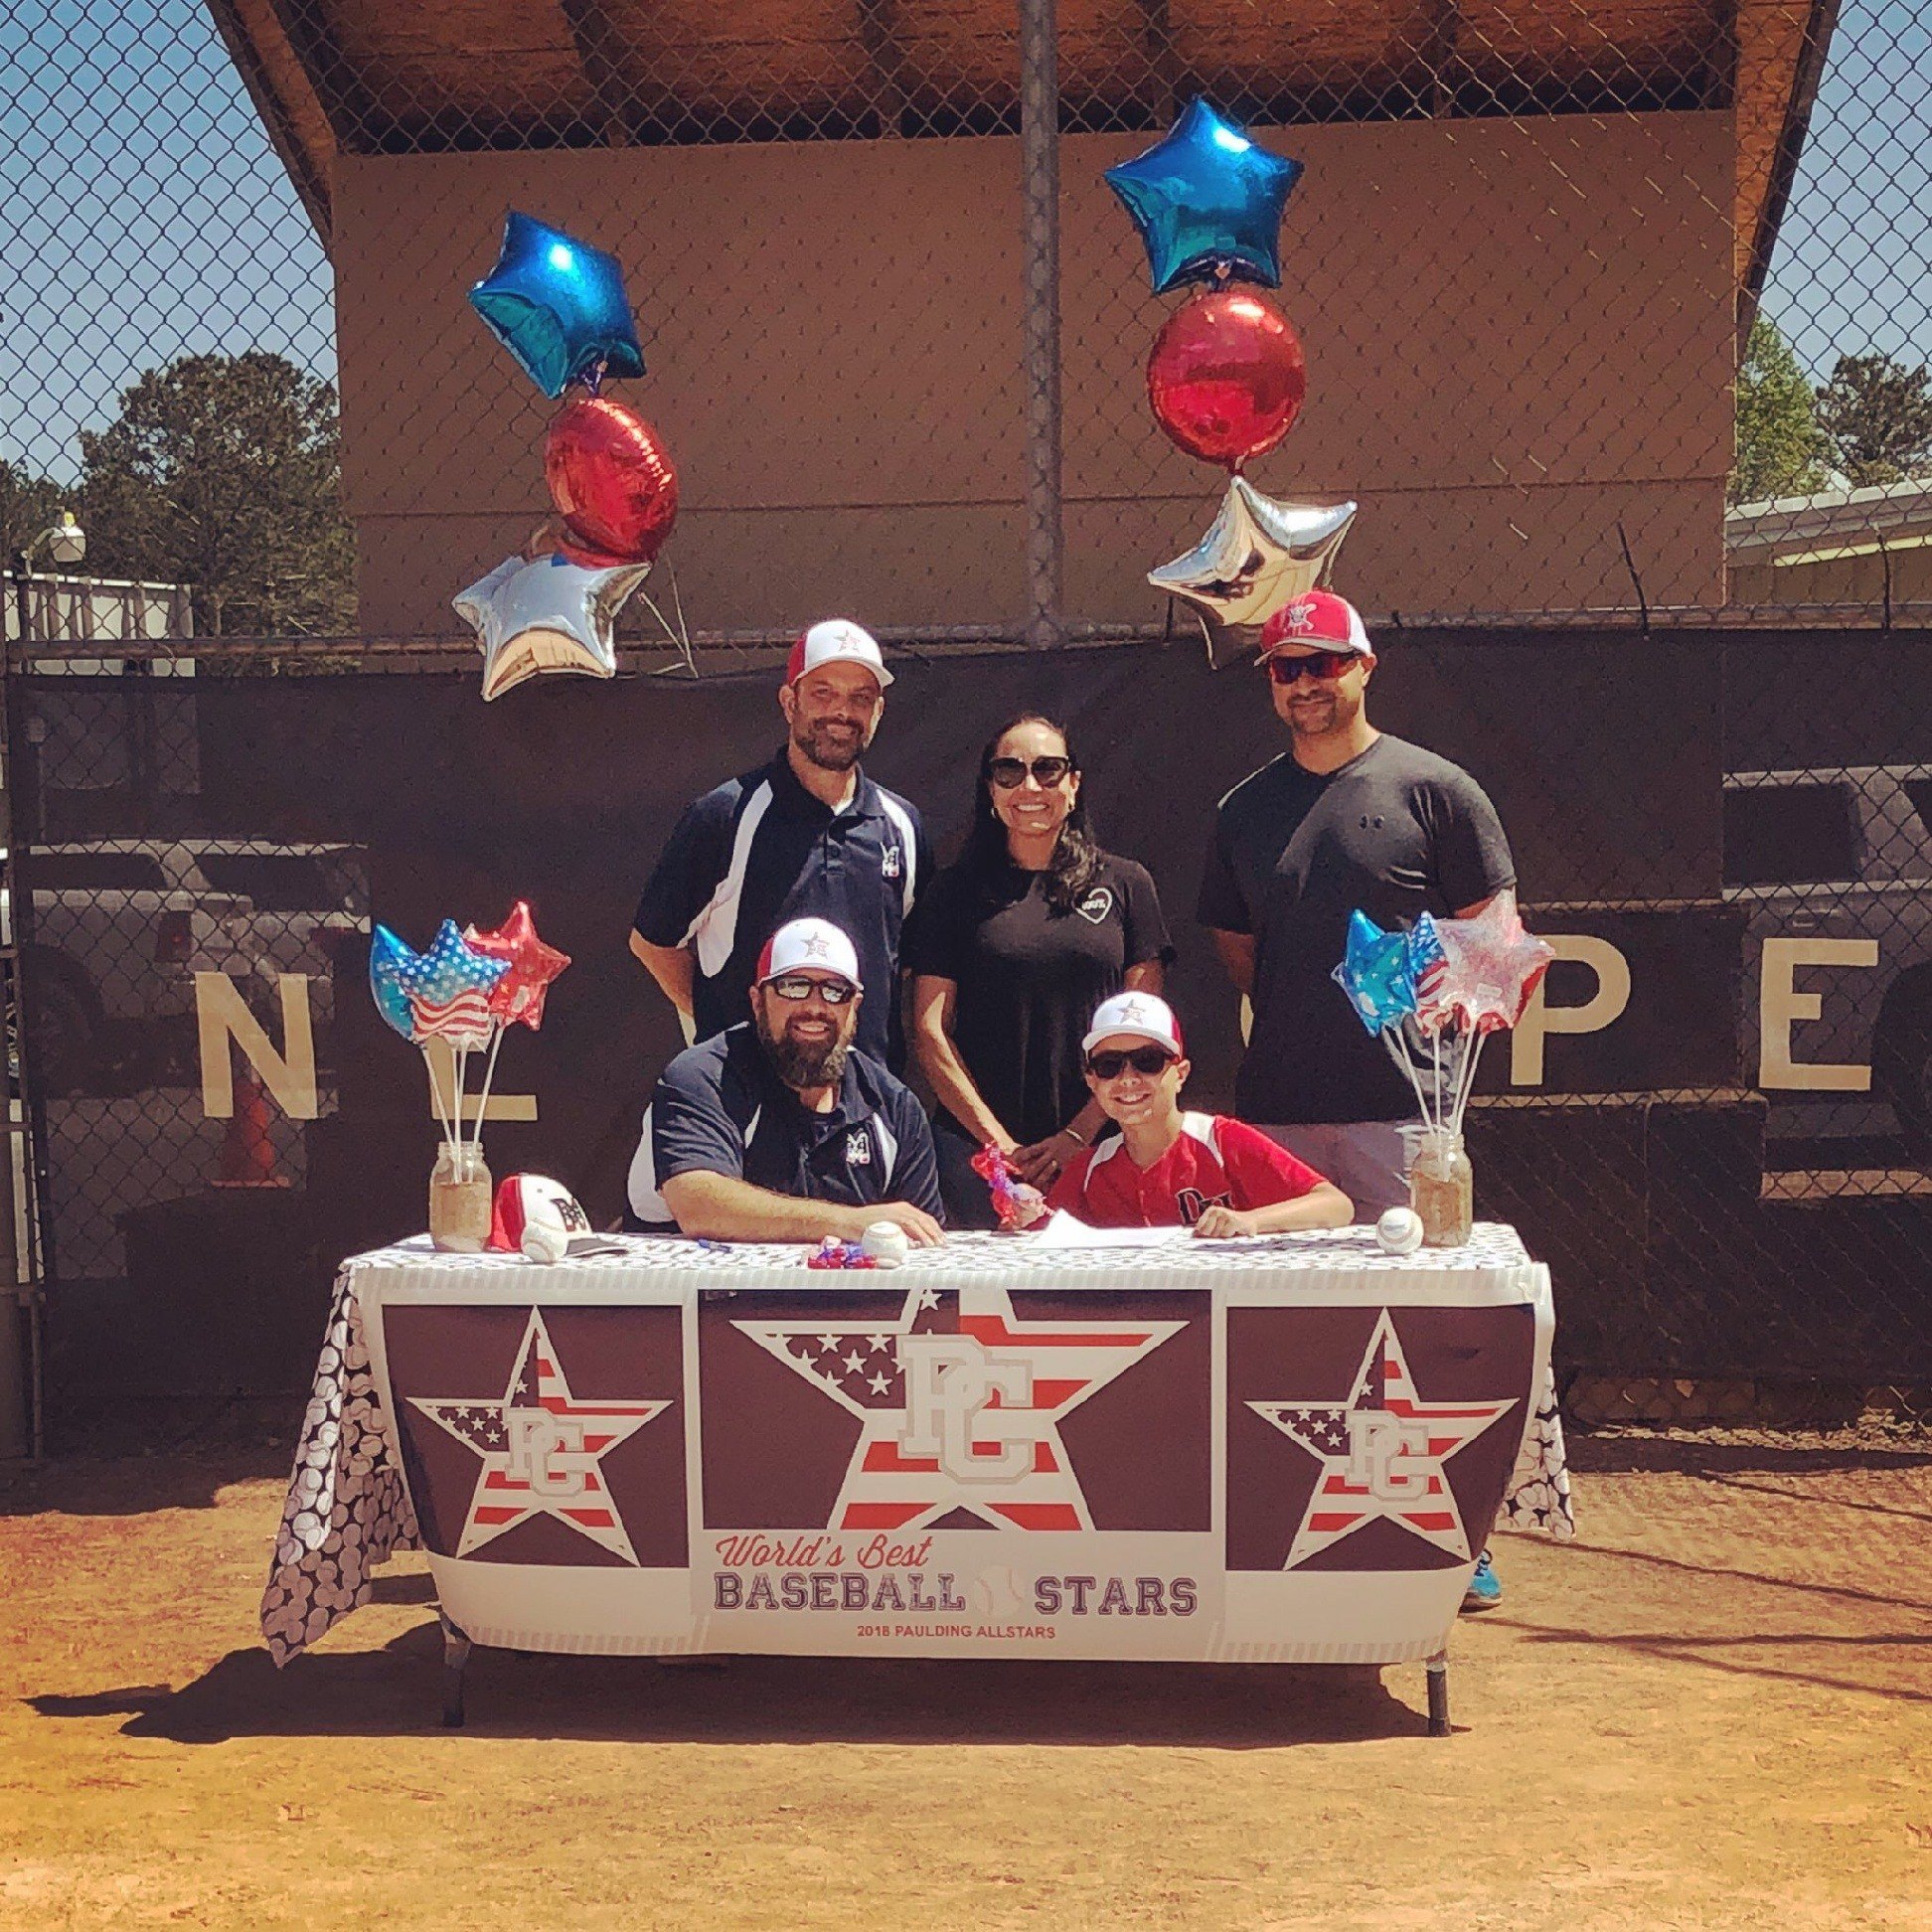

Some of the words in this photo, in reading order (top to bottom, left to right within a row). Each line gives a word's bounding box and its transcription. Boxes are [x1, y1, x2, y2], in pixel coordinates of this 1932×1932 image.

[895, 1335, 1037, 1485] PC
[504, 1407, 584, 1497] PC
[1344, 1409, 1429, 1501] PC
[715, 1533, 846, 1568] World's
[857, 1532, 934, 1570] Best
[714, 1571, 967, 1612] BASEBALL
[1034, 1576, 1199, 1617] STARS
[857, 1624, 891, 1638] 2018
[894, 1625, 973, 1639] PAULDING
[976, 1626, 1056, 1640] ALLSTARS
